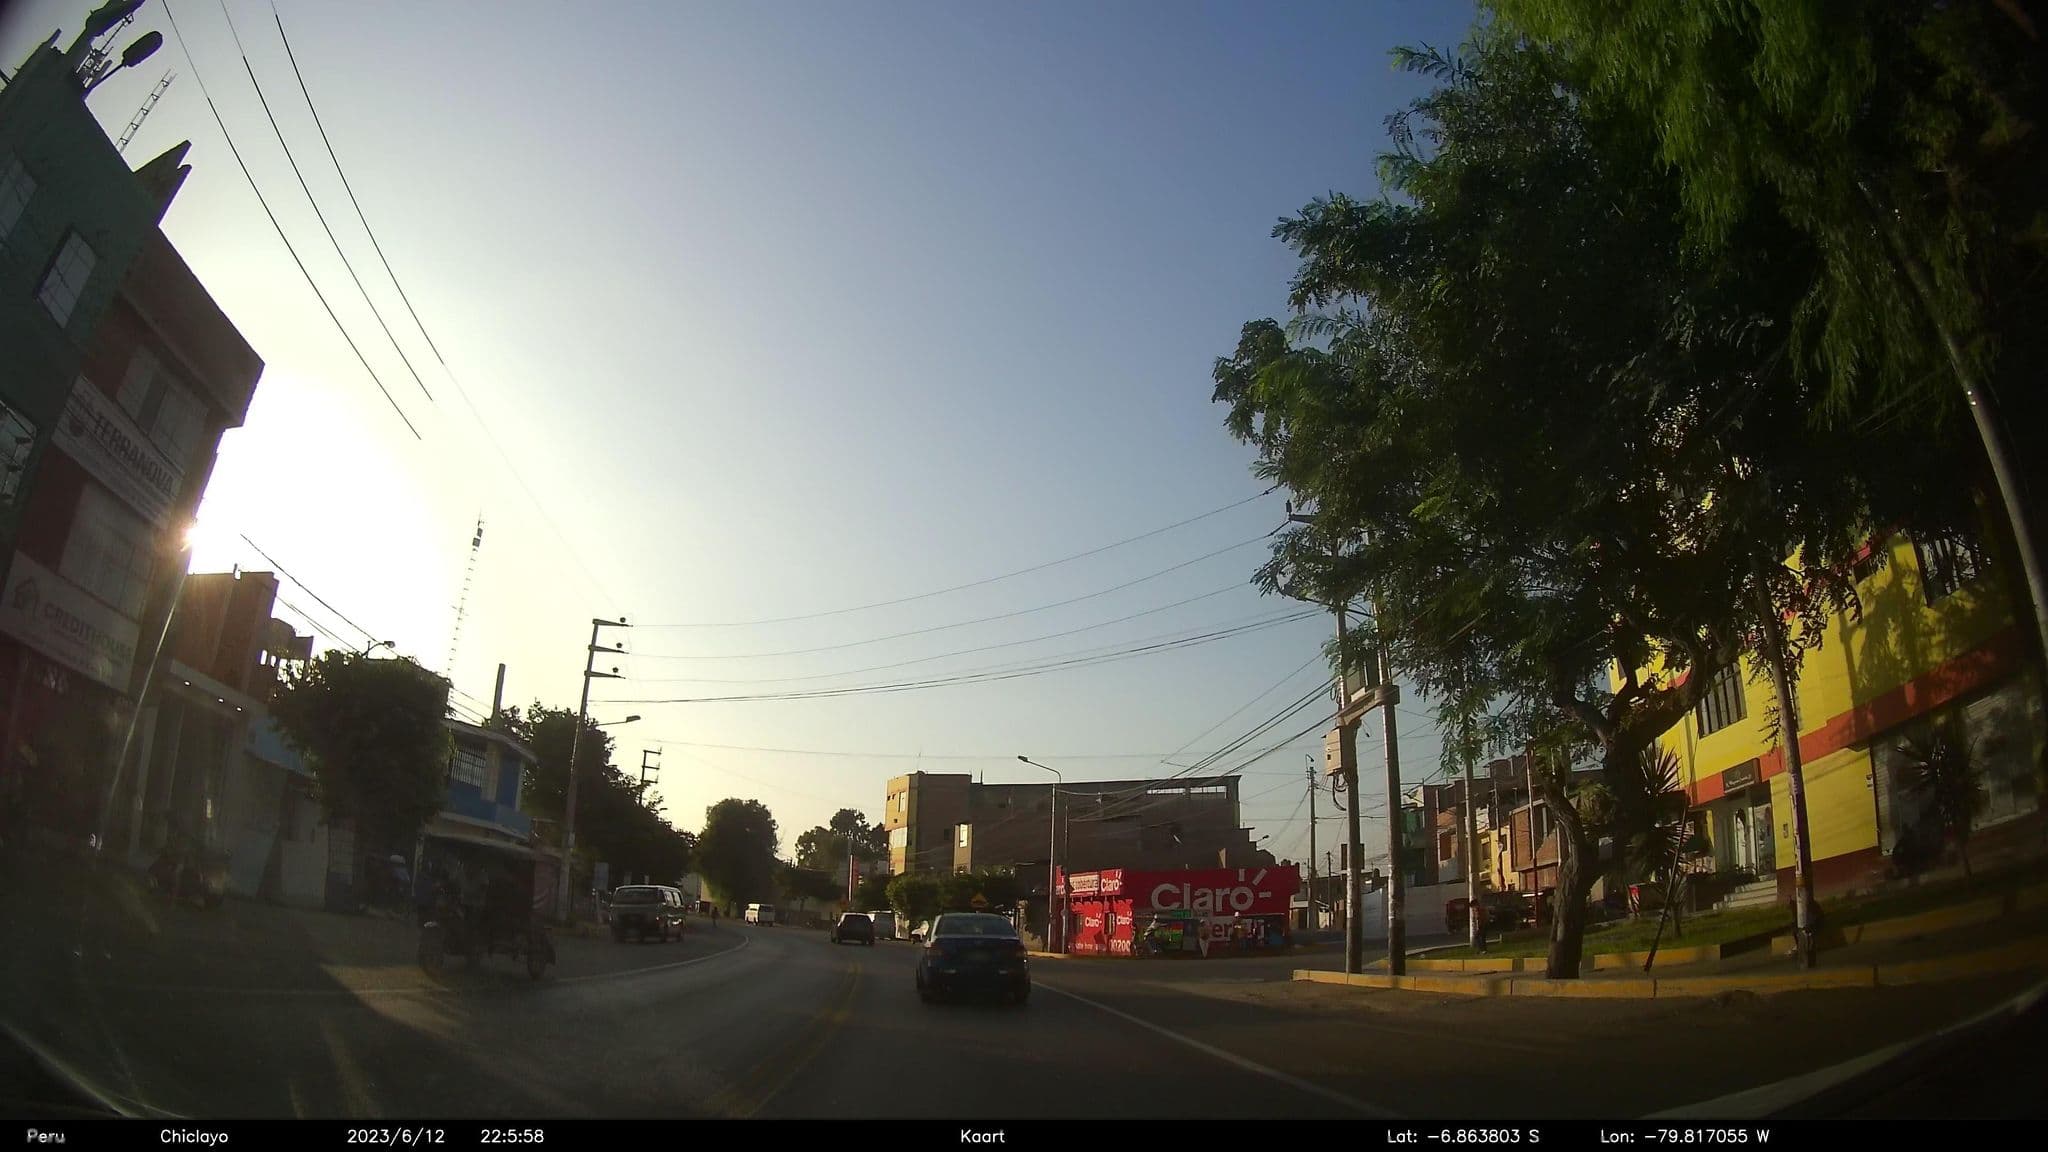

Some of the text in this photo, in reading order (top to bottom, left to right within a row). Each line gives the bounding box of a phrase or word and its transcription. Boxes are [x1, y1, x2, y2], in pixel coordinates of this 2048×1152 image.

[94, 412, 174, 497] TERRANOVA
[1101, 878, 1120, 892] Claro
[1151, 883, 1254, 911] Claro
